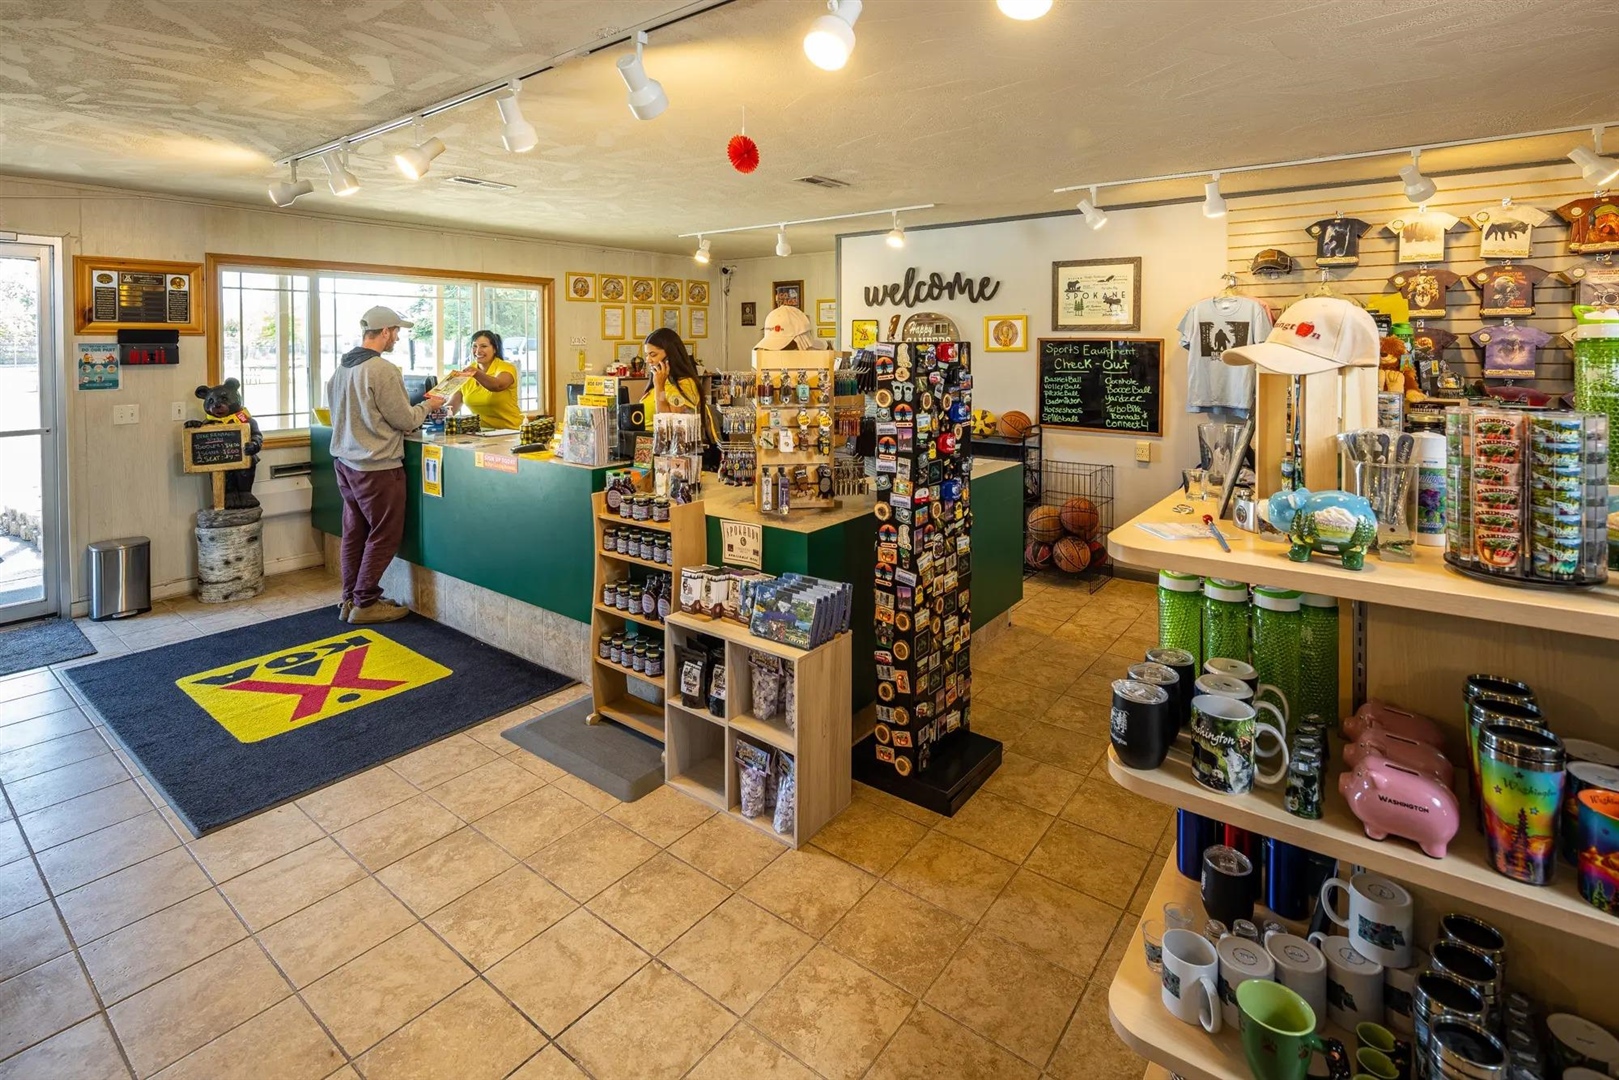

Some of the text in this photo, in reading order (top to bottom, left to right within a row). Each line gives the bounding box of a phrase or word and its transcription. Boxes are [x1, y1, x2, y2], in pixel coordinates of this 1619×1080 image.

[864, 267, 1000, 308] welcome
[1066, 291, 1126, 300] SPOKANE
[908, 321, 933, 336] Happy
[1046, 343, 1079, 356] Sports
[1043, 406, 1084, 414] Horseshoes
[1192, 724, 1236, 745] ashington
